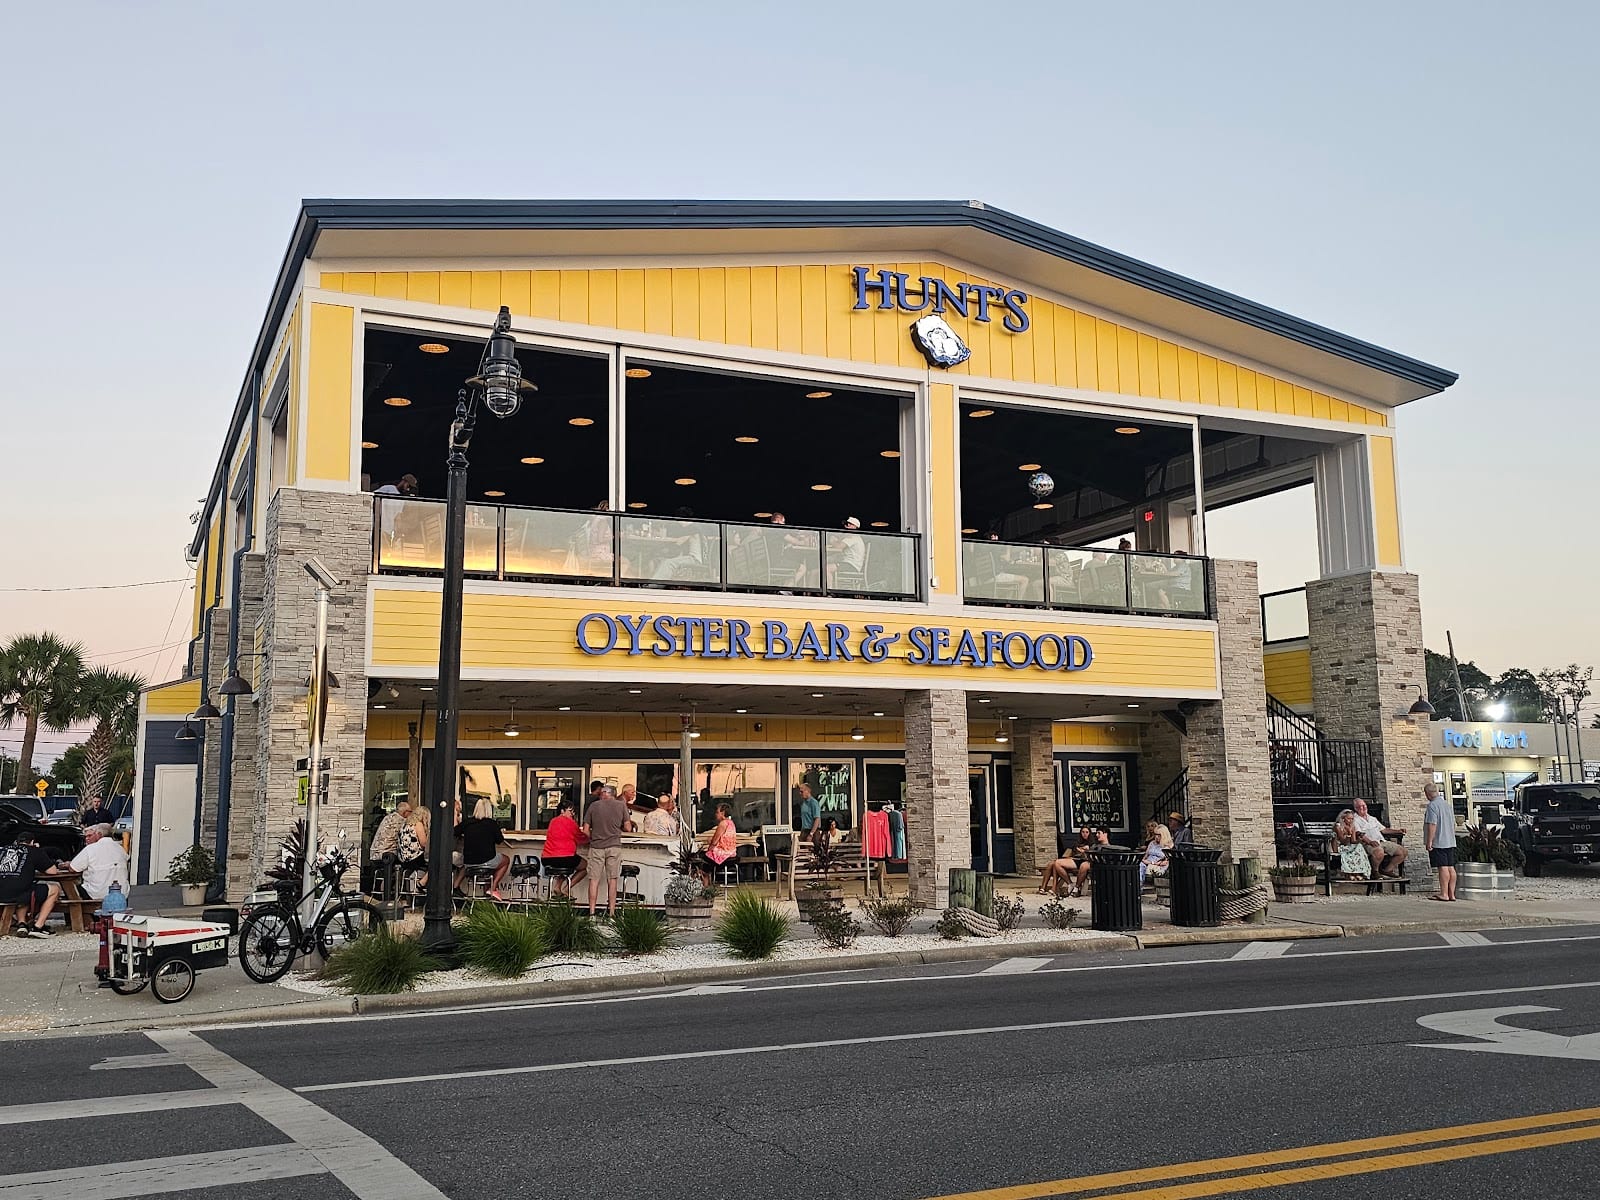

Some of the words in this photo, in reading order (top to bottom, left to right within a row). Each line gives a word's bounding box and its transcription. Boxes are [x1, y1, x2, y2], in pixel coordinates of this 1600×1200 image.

[853, 266, 1030, 333] HUNT'S
[576, 612, 755, 658] OYSTER
[762, 620, 853, 661] BAR
[860, 624, 901, 663] &
[908, 626, 1093, 671] SEAFOOD
[1443, 728, 1482, 748] Food
[1492, 729, 1529, 749] Mart
[1569, 823, 1591, 831] Jeep
